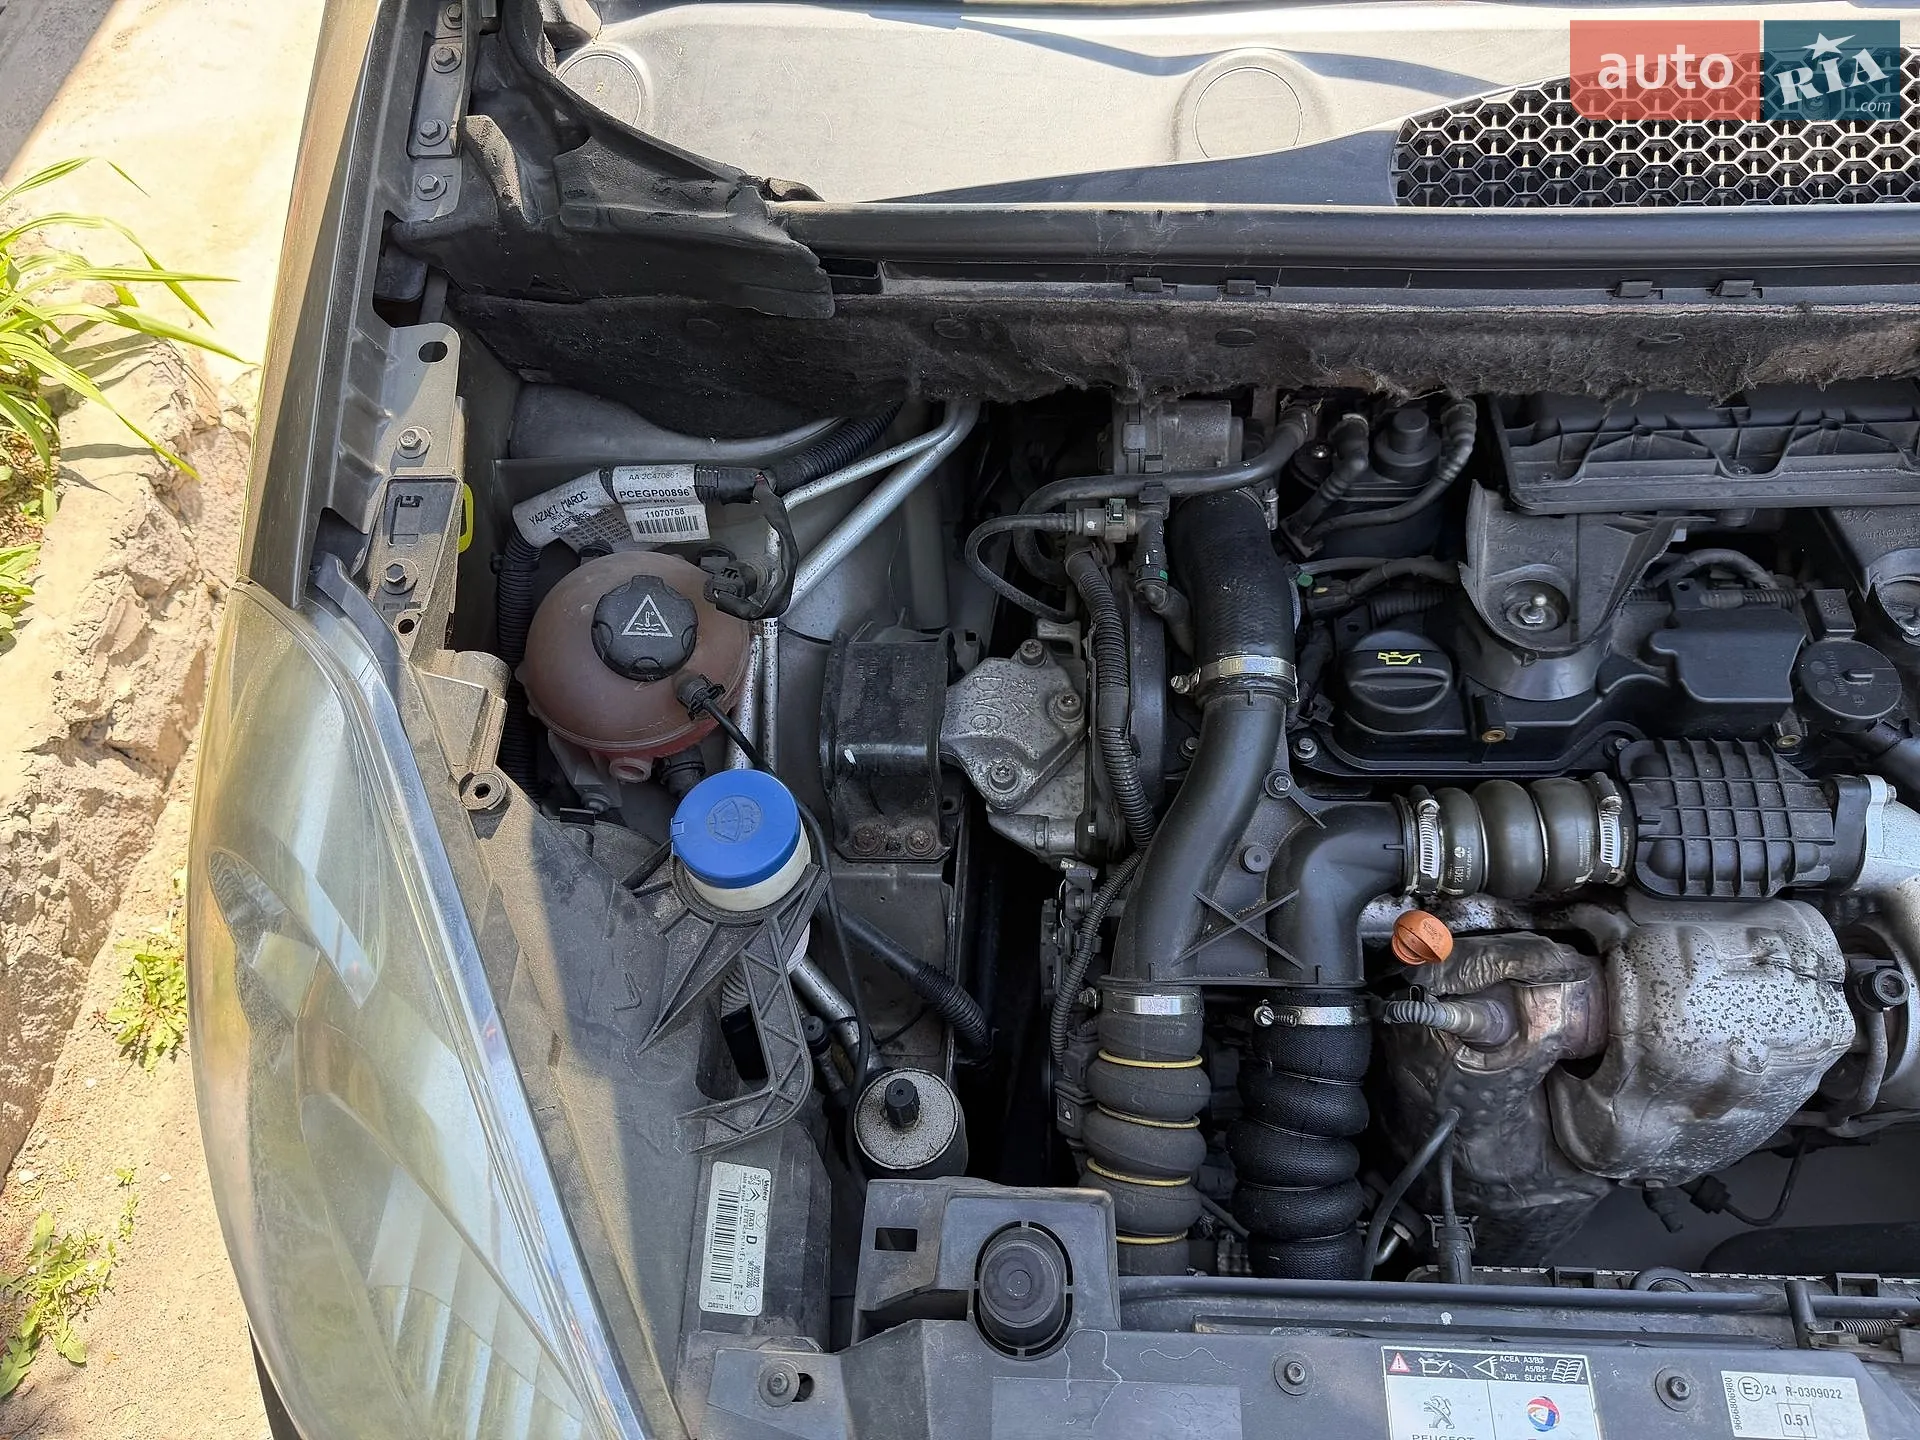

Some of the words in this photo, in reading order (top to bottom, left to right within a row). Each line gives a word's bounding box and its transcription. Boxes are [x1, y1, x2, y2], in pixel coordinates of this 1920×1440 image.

[618, 488, 690, 498] PCEGP00896
[528, 504, 559, 526] YAZAKI
[560, 490, 589, 508] MAROC
[746, 1235, 758, 1245] D
[1499, 1355, 1520, 1363] ACEA
[1764, 1385, 1777, 1396] 24
[1785, 1386, 1843, 1400] R-0309022
[1784, 1413, 1810, 1427] 0.51
